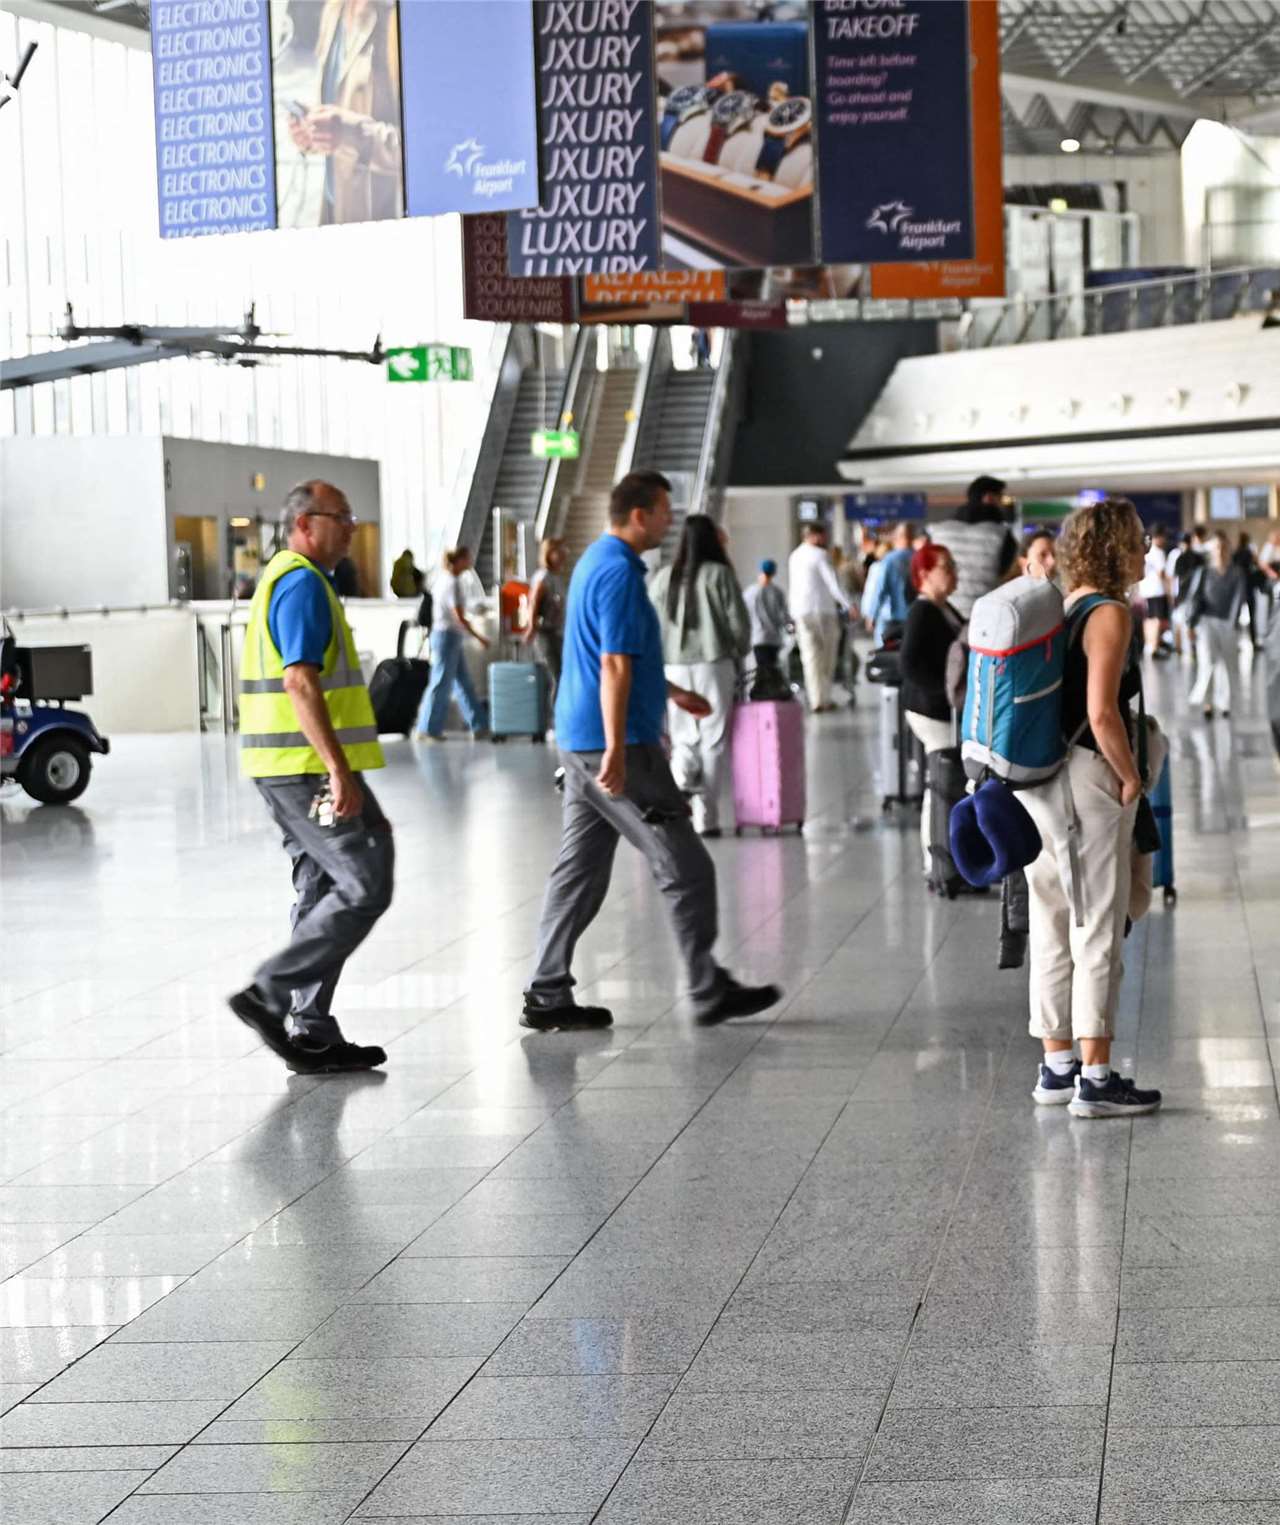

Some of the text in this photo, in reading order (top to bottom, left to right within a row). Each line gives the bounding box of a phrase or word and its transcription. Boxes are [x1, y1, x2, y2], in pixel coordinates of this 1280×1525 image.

[158, 22, 262, 58] ELECTRONICS
[827, 14, 920, 39] TAKEOFF
[160, 50, 263, 85] ELECTRONICS
[161, 79, 264, 113] ELECTRONICS
[161, 107, 264, 141] ELECTRONICS
[162, 135, 265, 170] ELECTRONICS
[163, 164, 266, 197] ELECTRONICS
[164, 192, 267, 225] ELECTRONICS
[521, 218, 647, 255] LUXURY
[900, 234, 946, 252] Airport
[901, 219, 962, 235] Frankfurt
